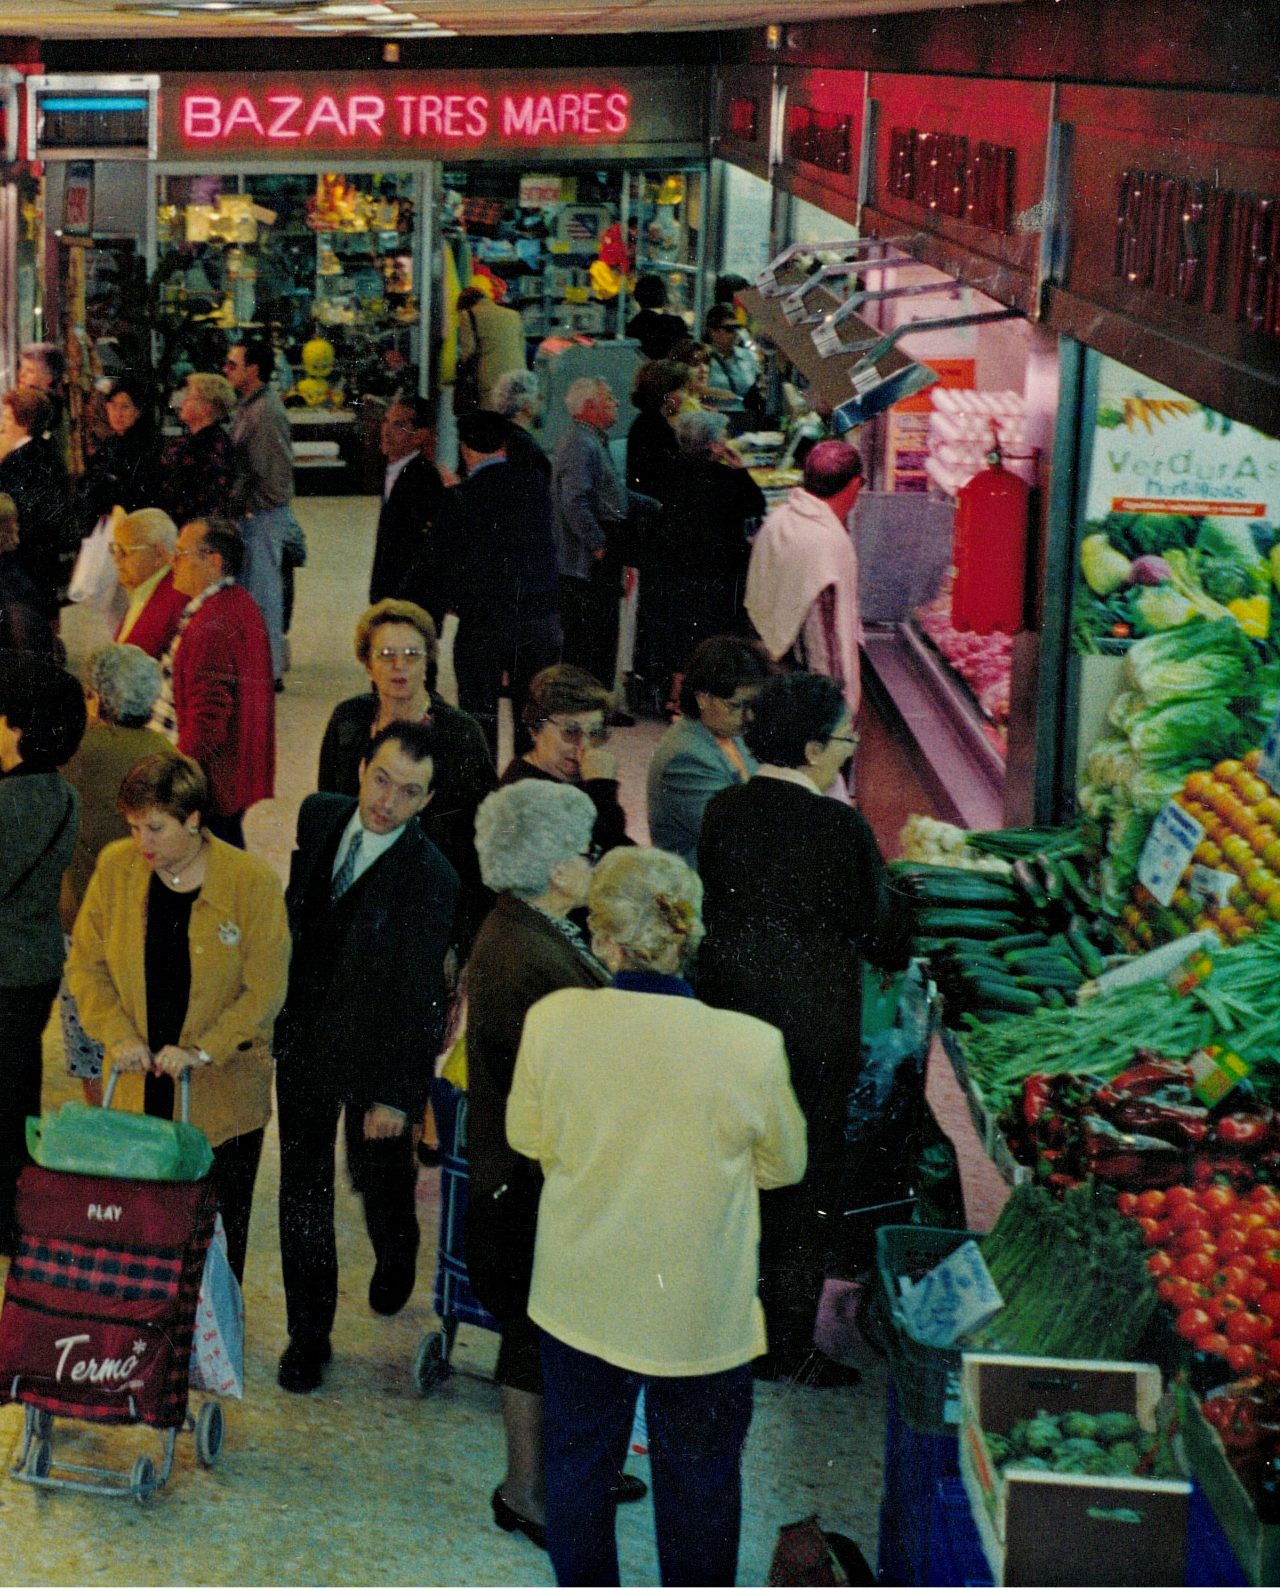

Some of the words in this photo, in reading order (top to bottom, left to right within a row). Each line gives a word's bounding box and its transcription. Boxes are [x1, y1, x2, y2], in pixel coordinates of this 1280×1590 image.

[184, 95, 386, 138] BAZAR
[397, 94, 488, 136] TRES
[503, 93, 629, 135] MARES
[87, 1203, 122, 1222] PLAY
